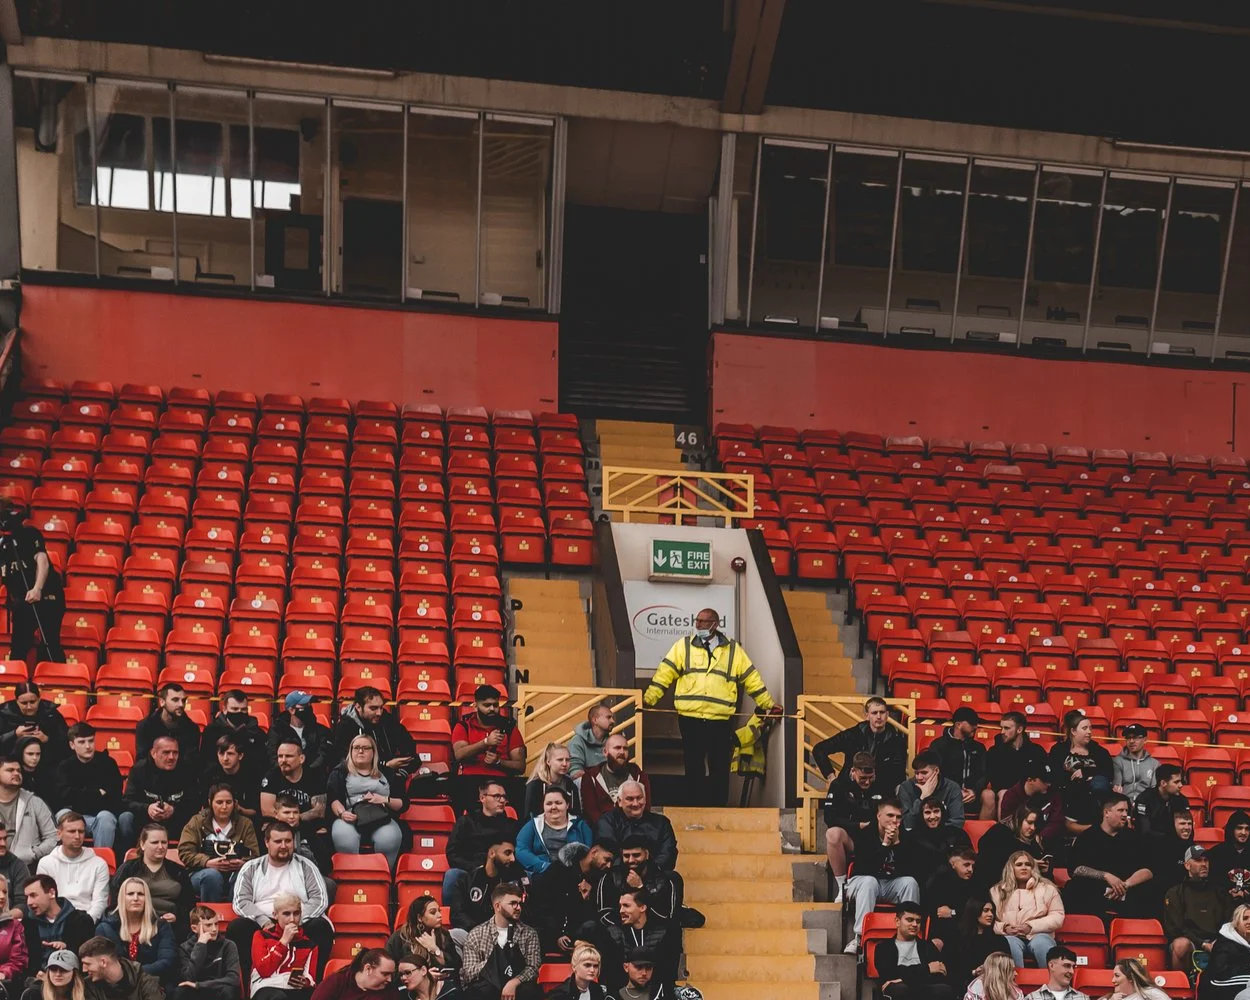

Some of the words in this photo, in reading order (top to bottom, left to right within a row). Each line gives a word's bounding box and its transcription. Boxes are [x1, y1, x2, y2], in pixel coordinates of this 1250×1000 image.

[676, 432, 697, 445] 46
[687, 551, 710, 561] FIRE
[687, 560, 709, 570] EXIT
[647, 612, 726, 628] Gatesd
[646, 627, 694, 636] International
